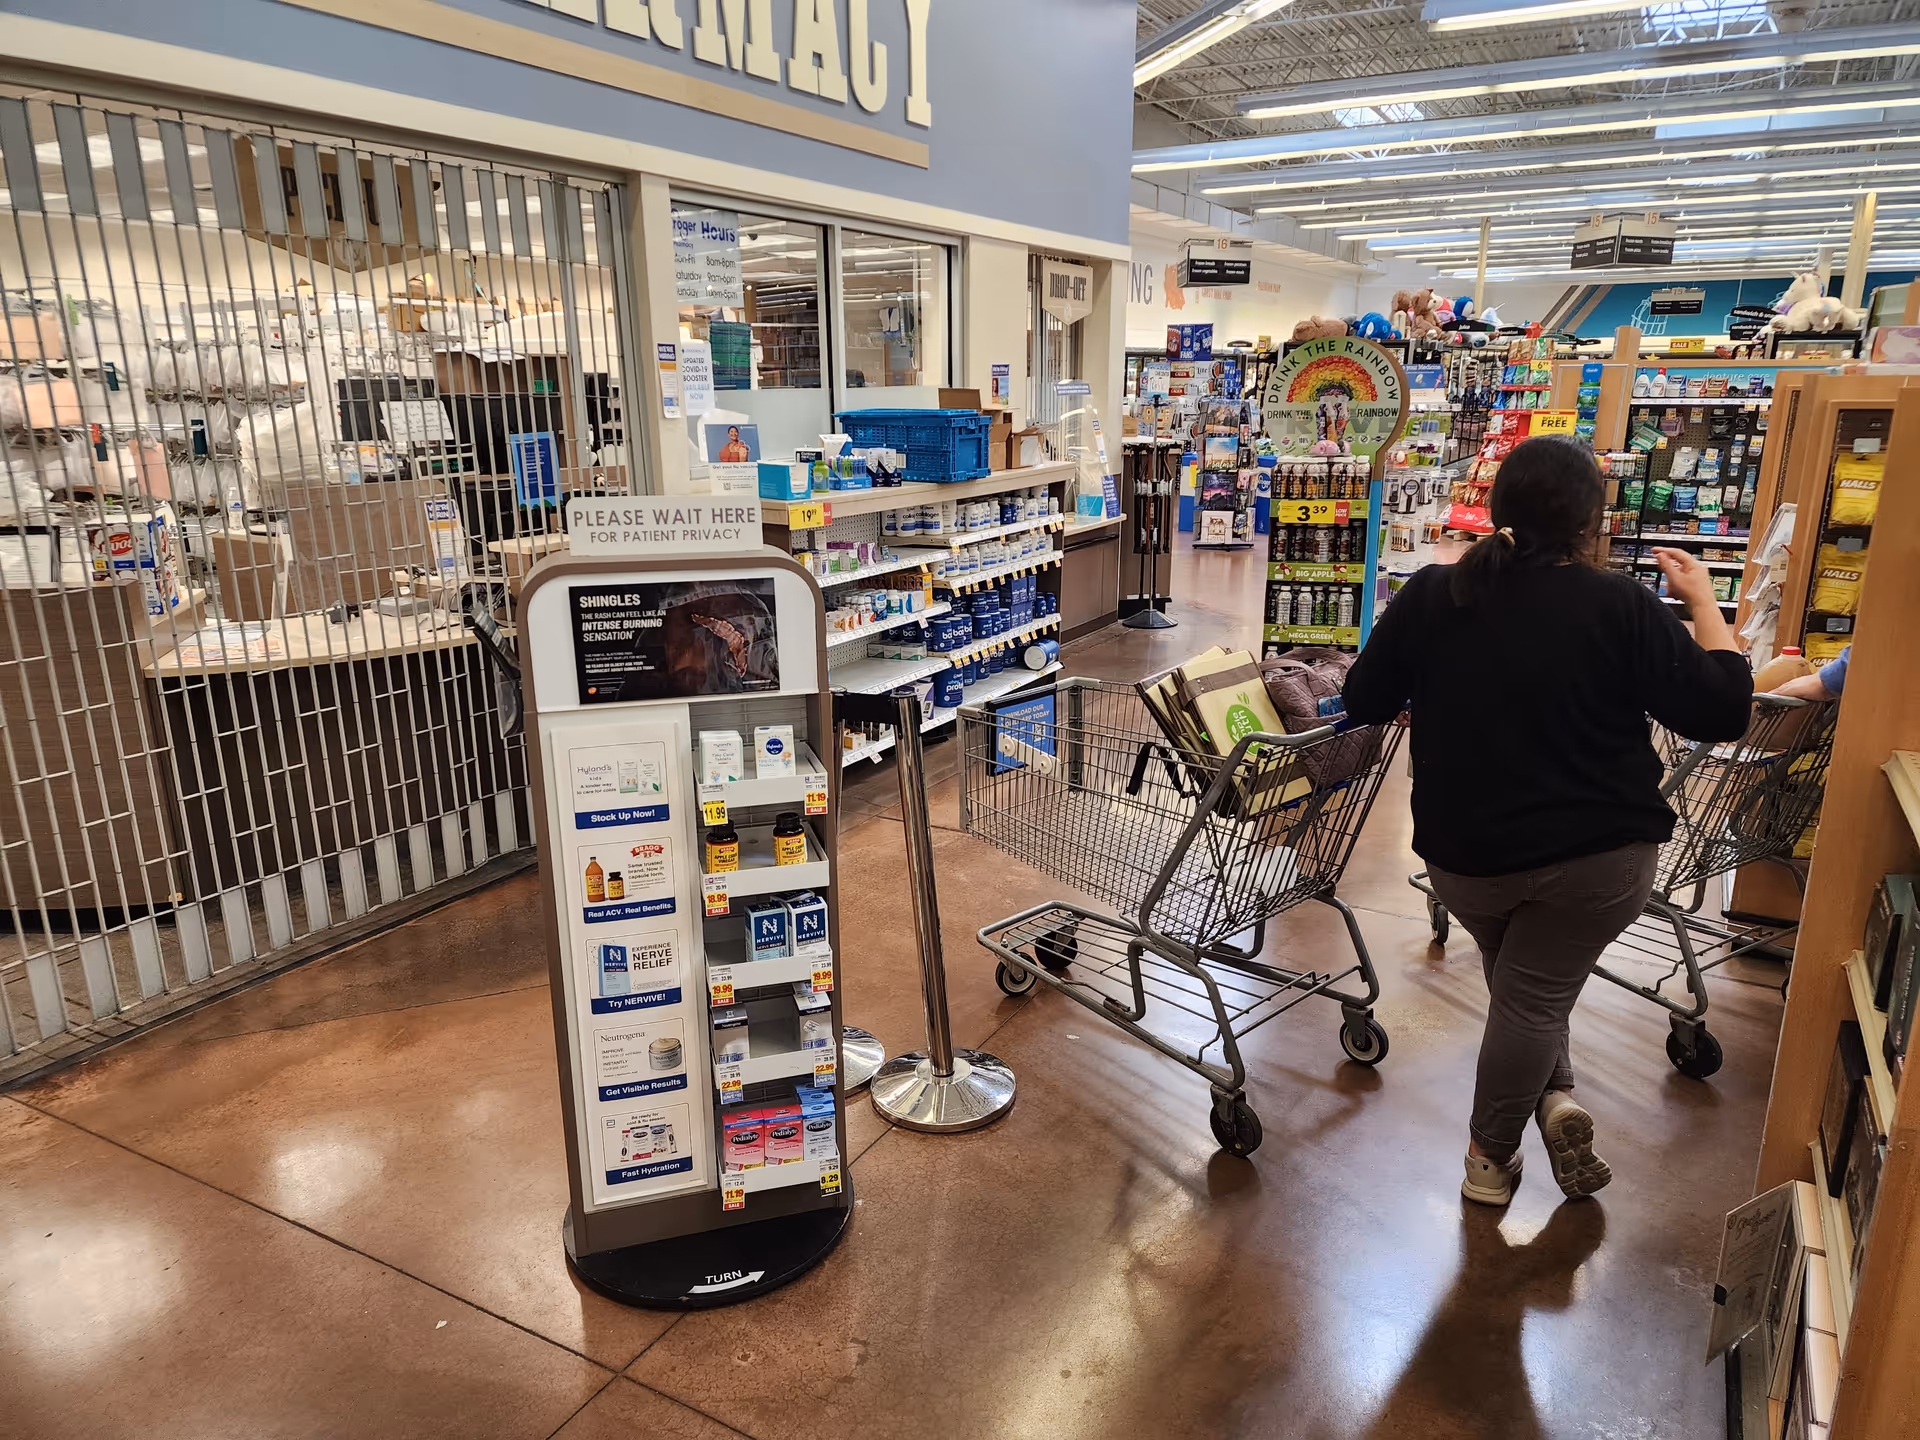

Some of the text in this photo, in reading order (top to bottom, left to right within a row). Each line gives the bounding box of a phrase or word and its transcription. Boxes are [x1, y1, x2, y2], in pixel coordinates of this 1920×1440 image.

[1591, 214, 1602, 228] 15
[1647, 212, 1658, 224] 15
[701, 221, 736, 242] Hours
[1217, 239, 1228, 250] 16
[706, 256, 736, 268] 8am-8pm
[707, 272, 738, 286] 9am-6pm
[1050, 272, 1087, 302] DROP-OFF
[1268, 340, 1399, 404] DRINK THE RAINBOW
[1268, 410, 1293, 420] DRINK
[1356, 408, 1399, 418] RAINBOW
[1541, 420, 1567, 428] FREE
[1840, 480, 1877, 490] HALLS
[574, 507, 756, 528] PLEASE WAIT HERE
[590, 528, 742, 544] FOR PATIENT PRIVACY
[1296, 570, 1336, 578] BIG APPLE
[1823, 569, 1859, 580] HALLS
[580, 594, 641, 608] SHINGLES
[582, 618, 663, 631] INTENSE BURNING
[583, 631, 633, 642] SENSATION
[1288, 632, 1334, 640] MEGA GREEN
[1033, 710, 1050, 719] TODAY
[577, 764, 612, 775] Hyland's
[591, 810, 655, 823] Stock Up Now!
[704, 807, 726, 820] 11.99
[707, 893, 727, 903] 18.99
[588, 903, 674, 918] Real ACV. Real Benefits.
[762, 918, 777, 935] N
[803, 914, 818, 932] N
[757, 935, 784, 943] NERVIVE
[798, 930, 824, 940] NERVIVE
[632, 942, 671, 952] EXPERIENCE
[633, 948, 672, 961] NERVE
[633, 957, 672, 971] RELIEF
[813, 971, 832, 981] 19.99
[712, 984, 733, 994] 19.99
[608, 993, 665, 1008] Try NERVIVE!
[600, 1032, 646, 1042] Neutrogena
[816, 1064, 834, 1072] 22.99
[606, 1078, 681, 1096] Get Visible Results
[721, 1080, 741, 1088] 22.99
[808, 1122, 832, 1131] Pedialyte
[733, 1132, 759, 1142] Pedialyte
[772, 1128, 798, 1137] Pedialyte
[622, 1162, 680, 1178] Fast Hydration
[821, 1174, 839, 1184] 8.29
[725, 1190, 744, 1199] 11.19
[705, 1270, 742, 1284] TURN
